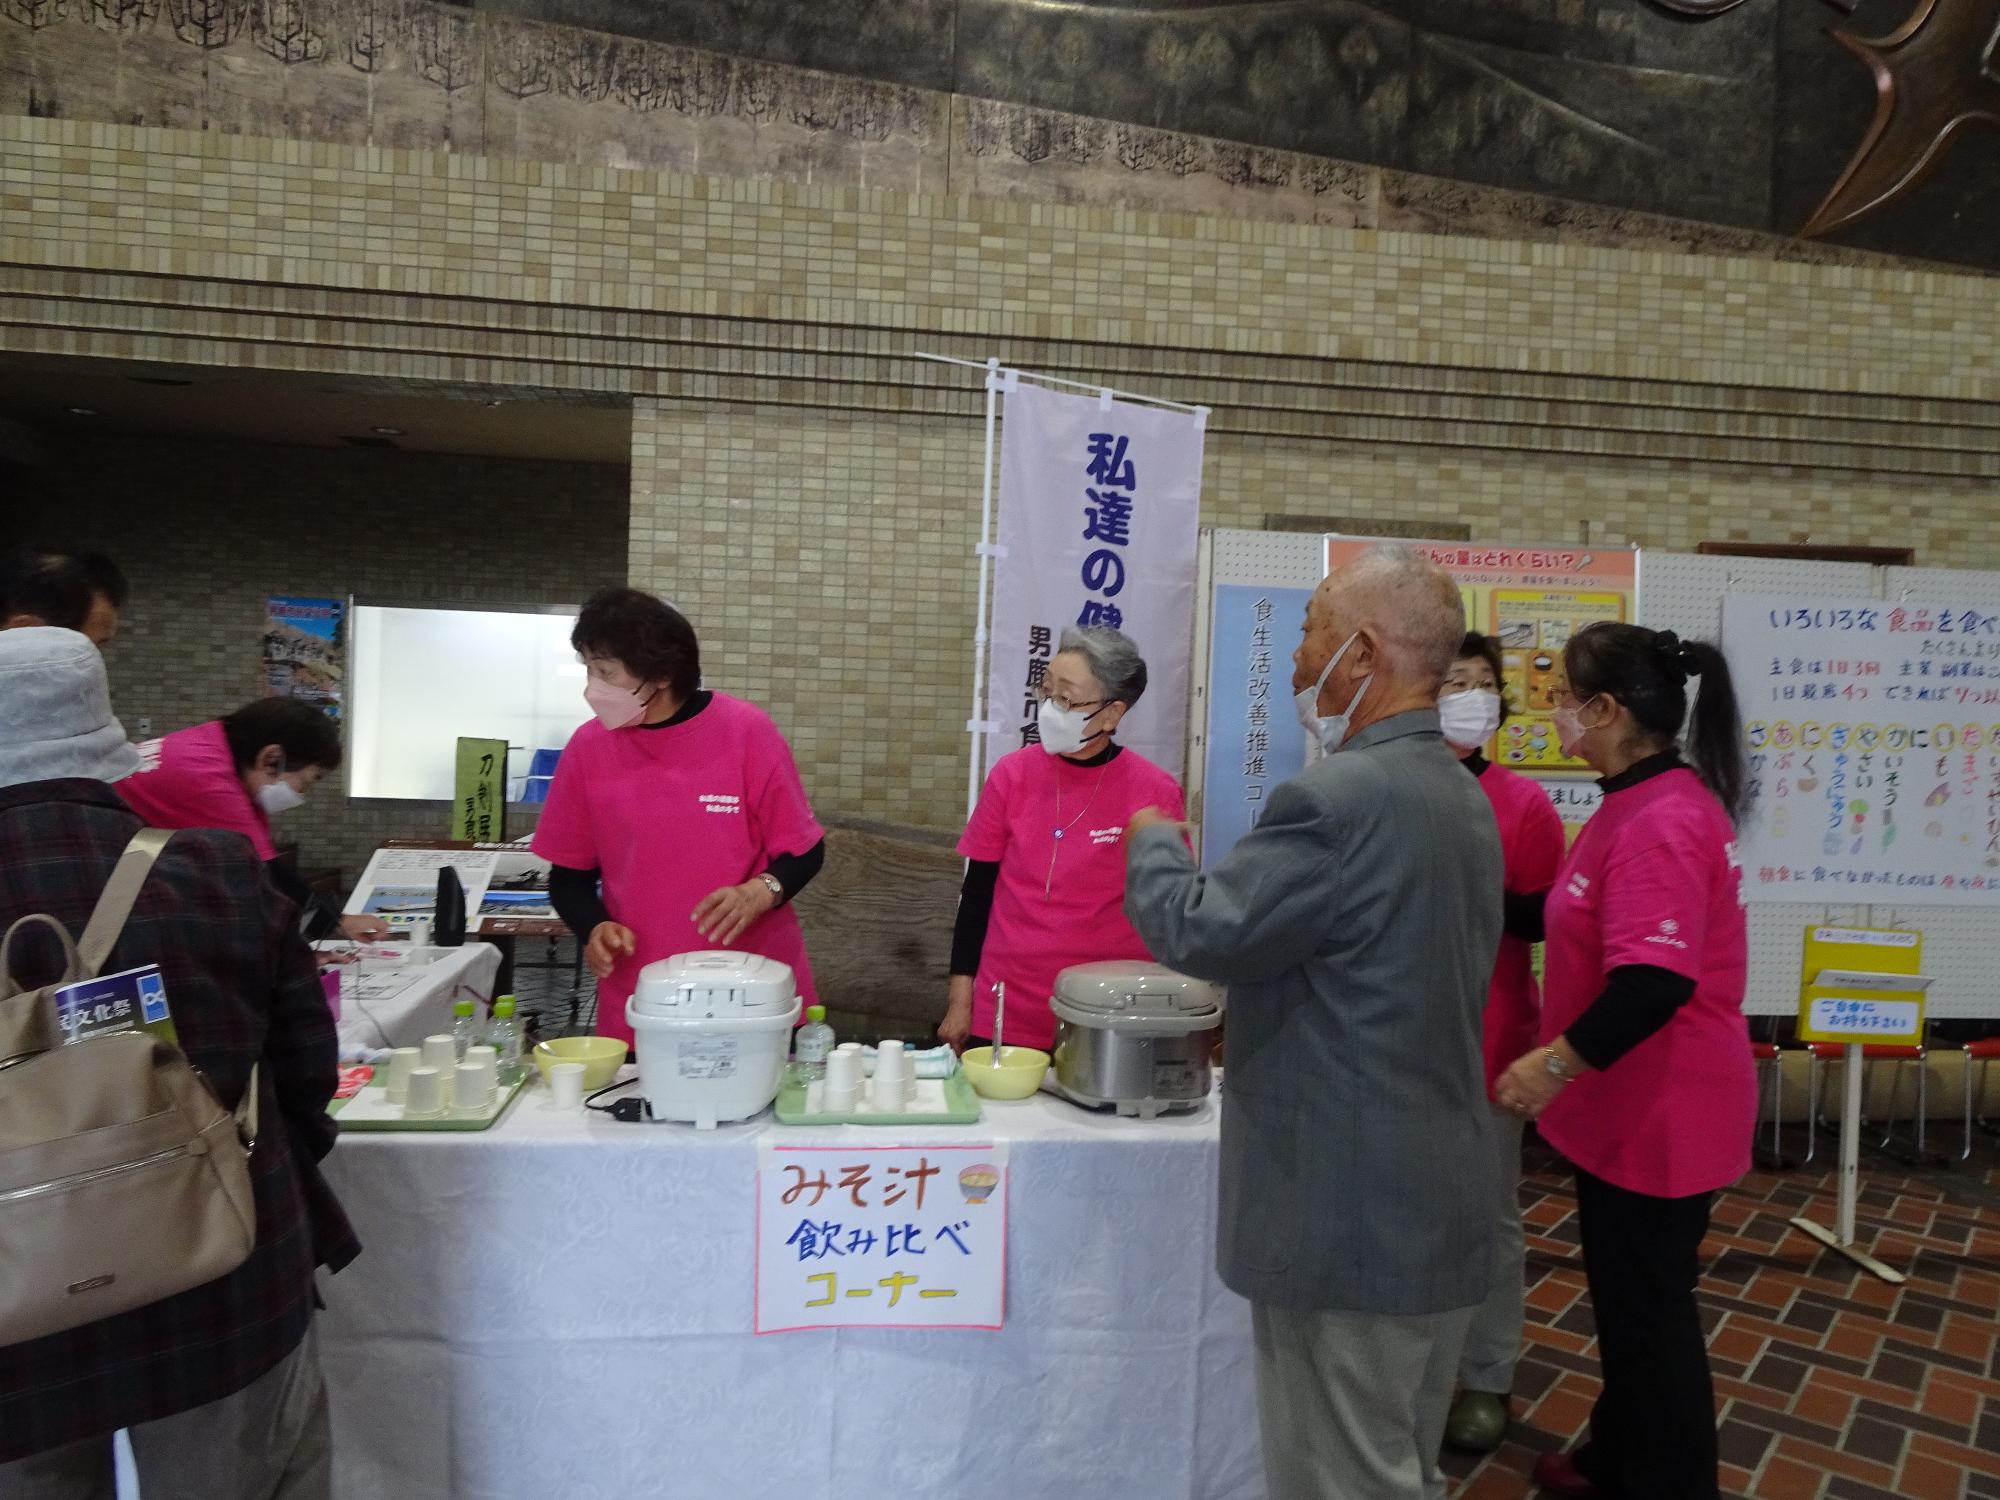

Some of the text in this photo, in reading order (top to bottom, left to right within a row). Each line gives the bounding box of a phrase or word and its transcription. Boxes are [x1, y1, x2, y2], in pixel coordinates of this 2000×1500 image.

[781, 1157, 941, 1210] みそ汁
[785, 1218, 971, 1262] 飲み比べ
[805, 1271, 958, 1308] コーナー
